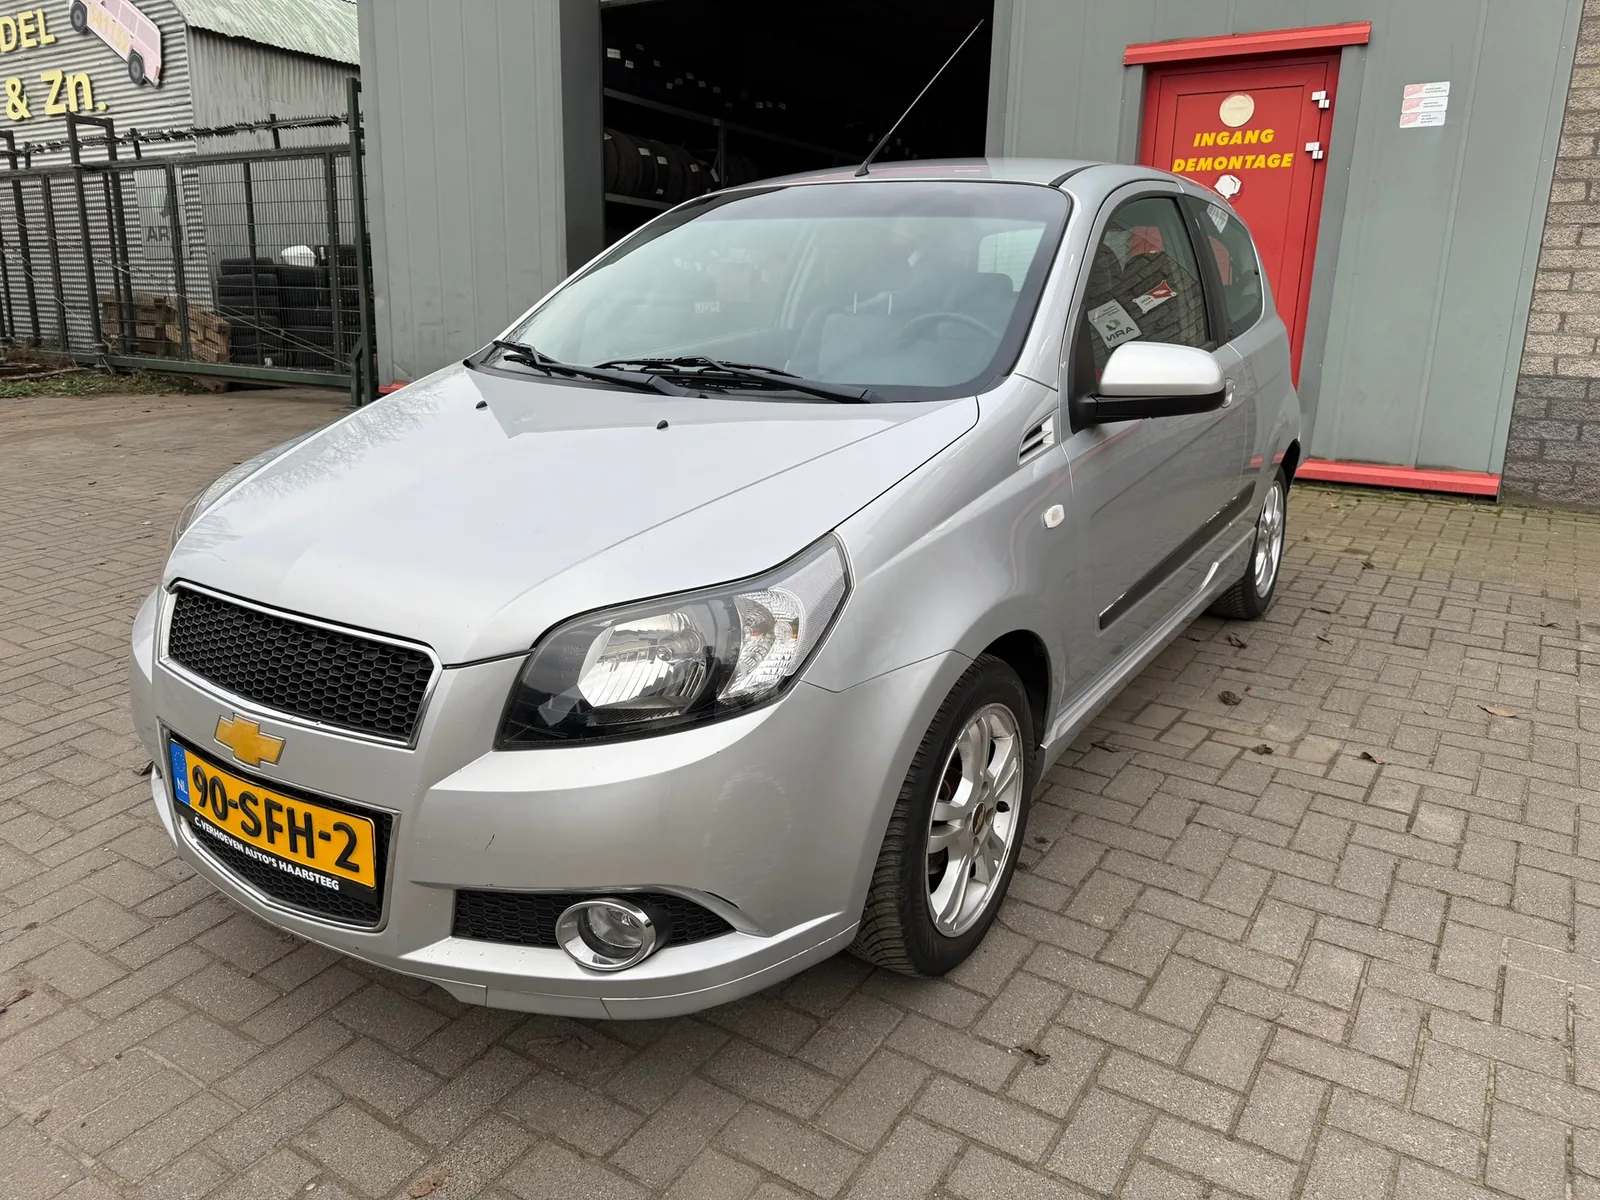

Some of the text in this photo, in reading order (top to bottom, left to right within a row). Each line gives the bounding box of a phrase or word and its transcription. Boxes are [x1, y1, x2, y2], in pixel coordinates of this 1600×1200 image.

[0, 8, 56, 52] DEL
[5, 69, 107, 120] & Zn.
[1193, 129, 1274, 147] INGANG
[1172, 153, 1294, 173] DEMONTAGE
[177, 777, 189, 795] NL
[192, 765, 360, 873] 90-SFH-2
[245, 847, 278, 868] AUTO'S
[278, 860, 340, 891] HAARSTEEG
